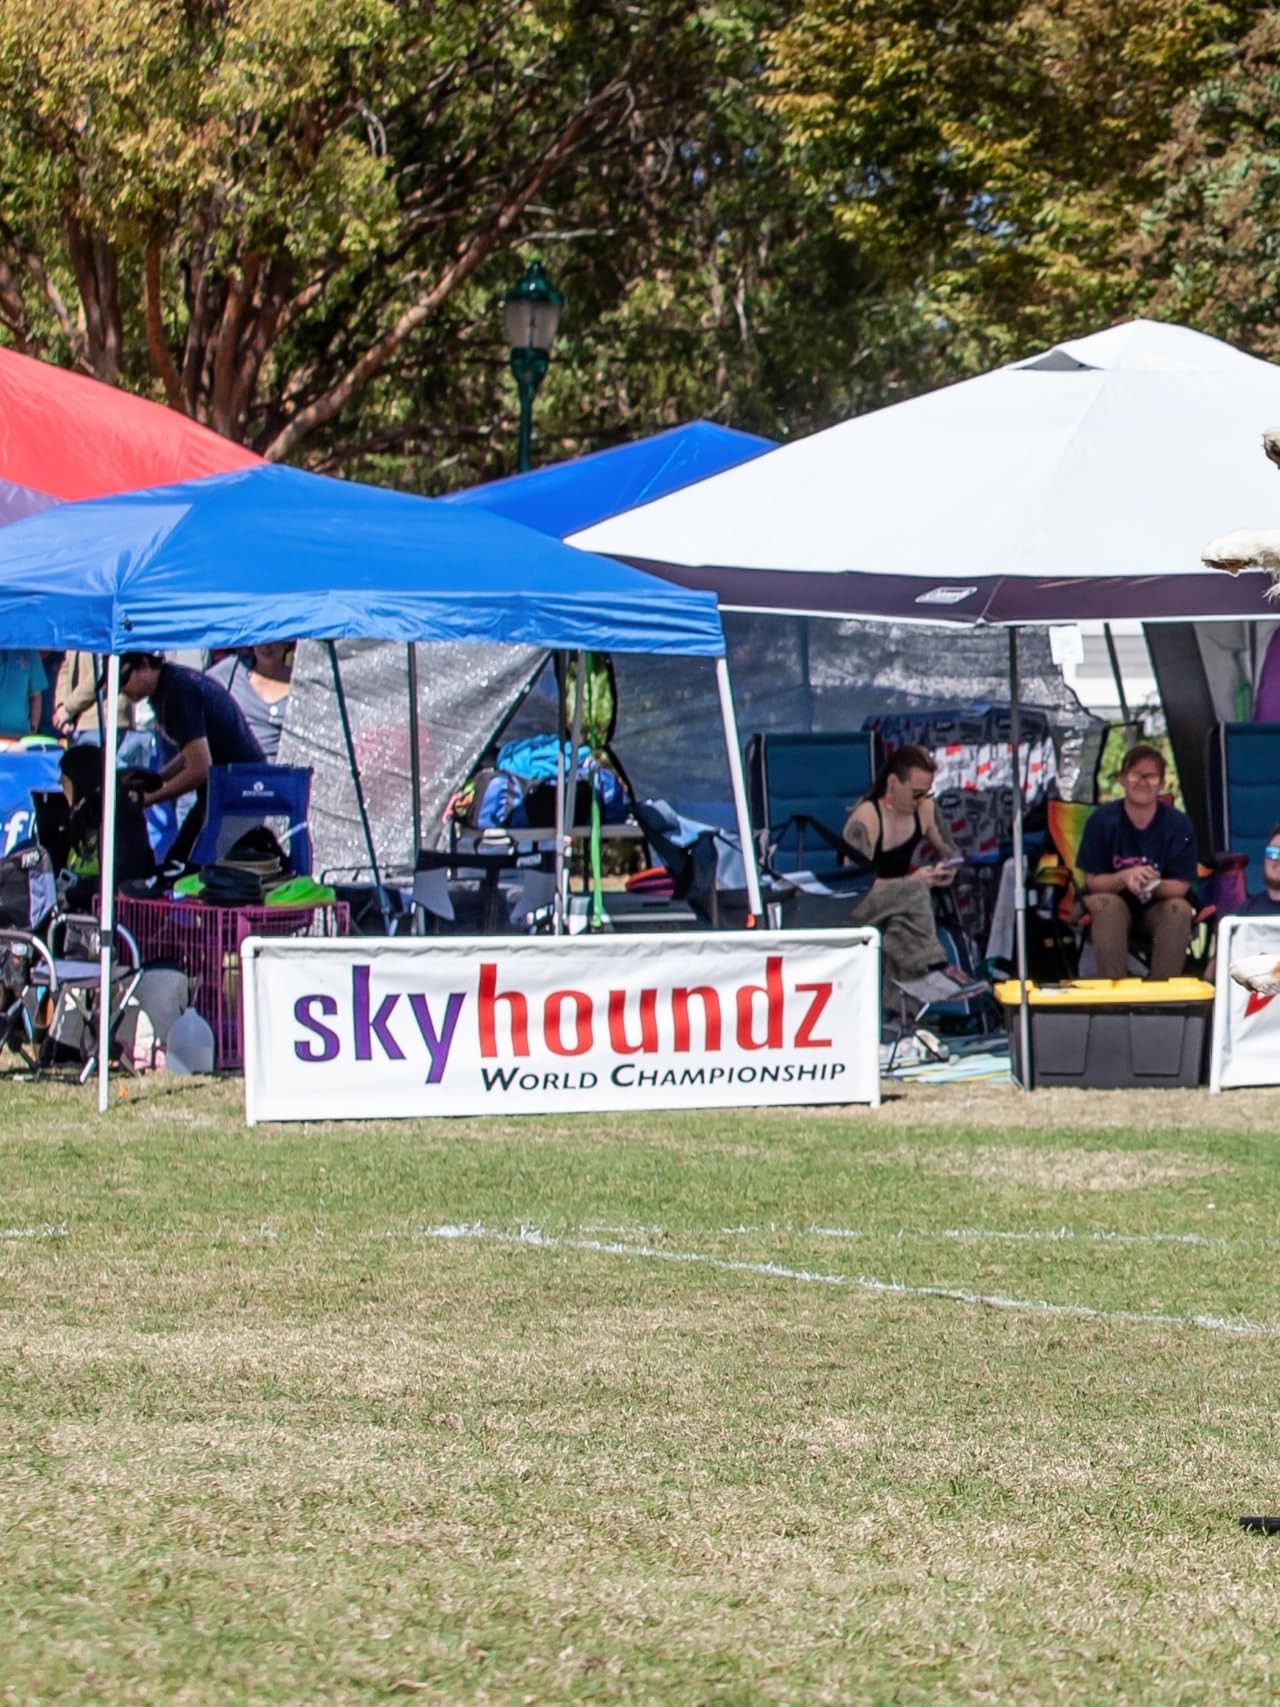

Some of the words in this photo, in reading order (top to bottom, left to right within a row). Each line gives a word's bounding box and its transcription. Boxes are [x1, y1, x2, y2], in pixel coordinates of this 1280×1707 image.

[293, 956, 834, 1085] skyhoundz
[481, 1067, 598, 1092] WORLD
[610, 1062, 848, 1088] CHAMPIONSHIP
